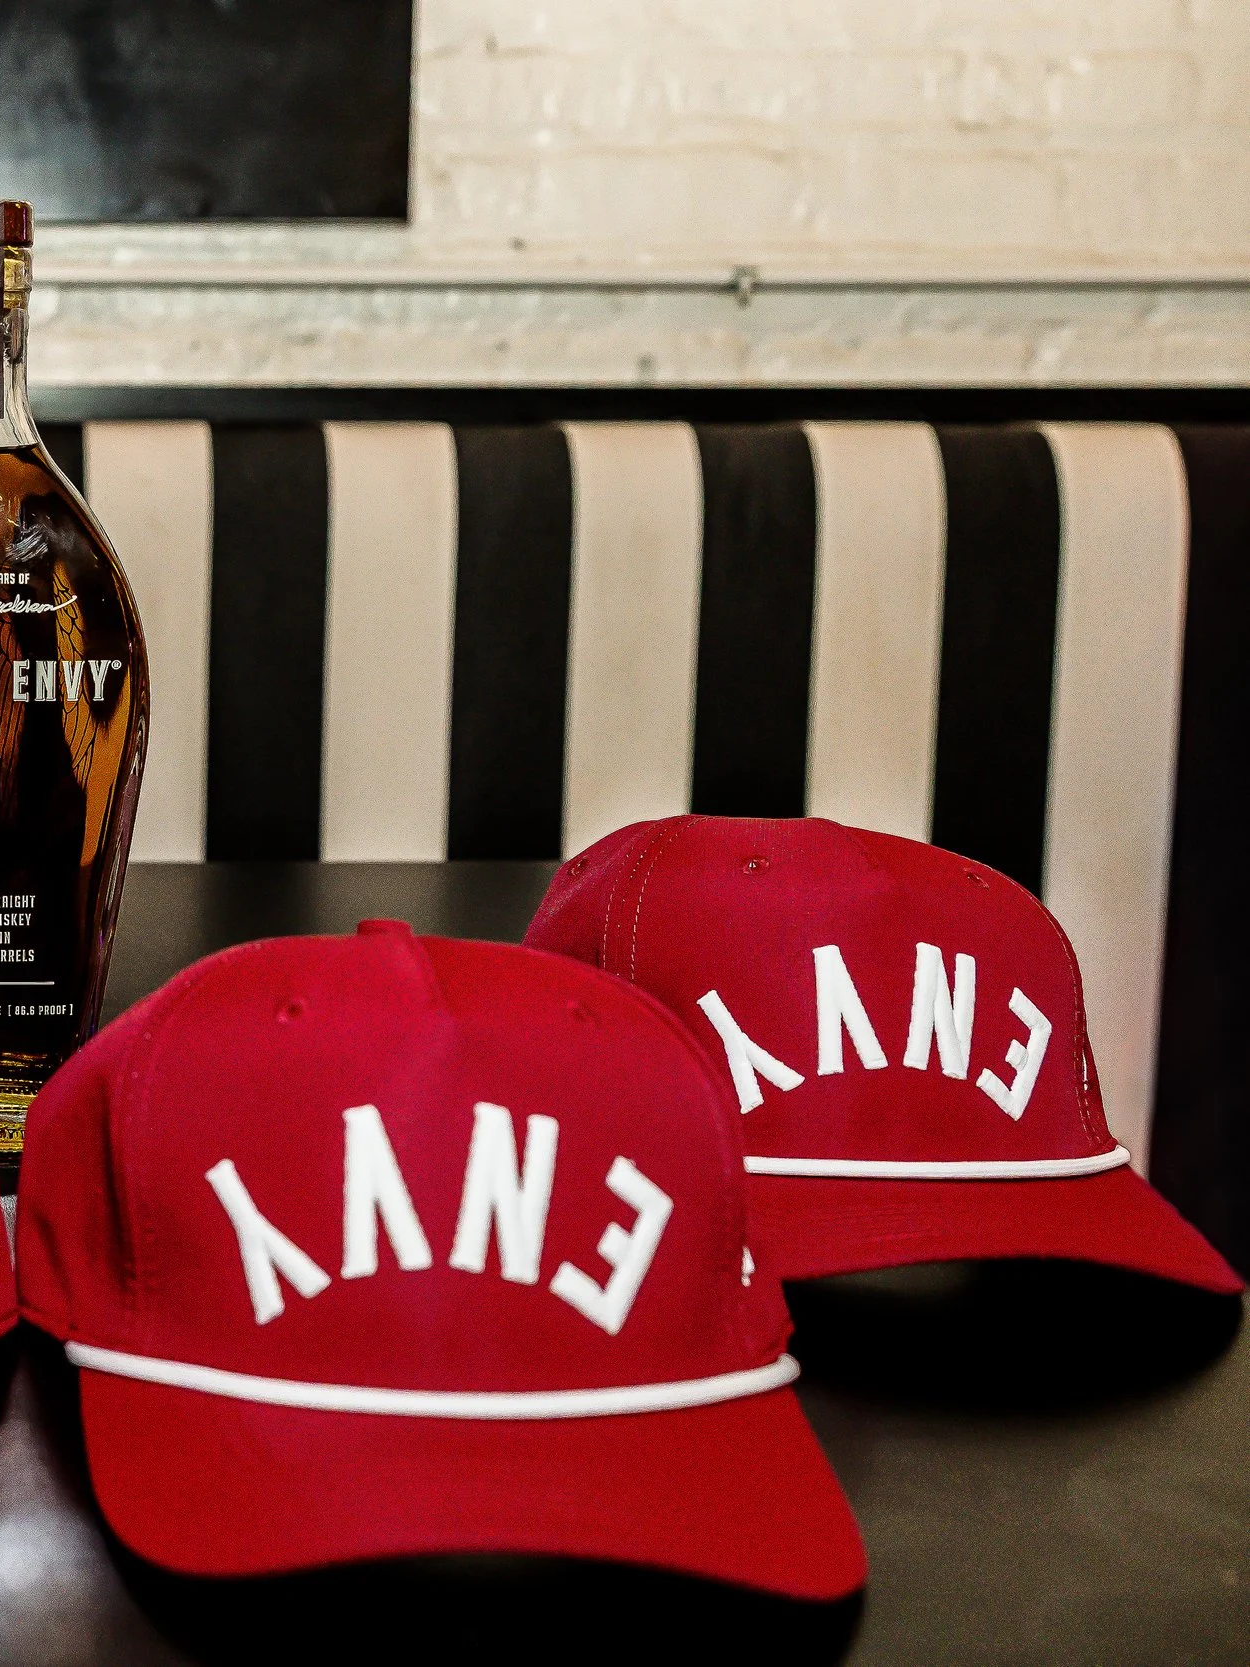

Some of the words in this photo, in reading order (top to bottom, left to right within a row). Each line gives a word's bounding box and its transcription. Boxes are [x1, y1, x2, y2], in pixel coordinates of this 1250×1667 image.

[18, 573, 30, 584] OF
[0, 931, 11, 945] IN
[14, 1004, 35, 1016] 86.6
[38, 1004, 67, 1016] PROOF
[697, 942, 1052, 1121] ENVY
[204, 1101, 674, 1335] ENVY
